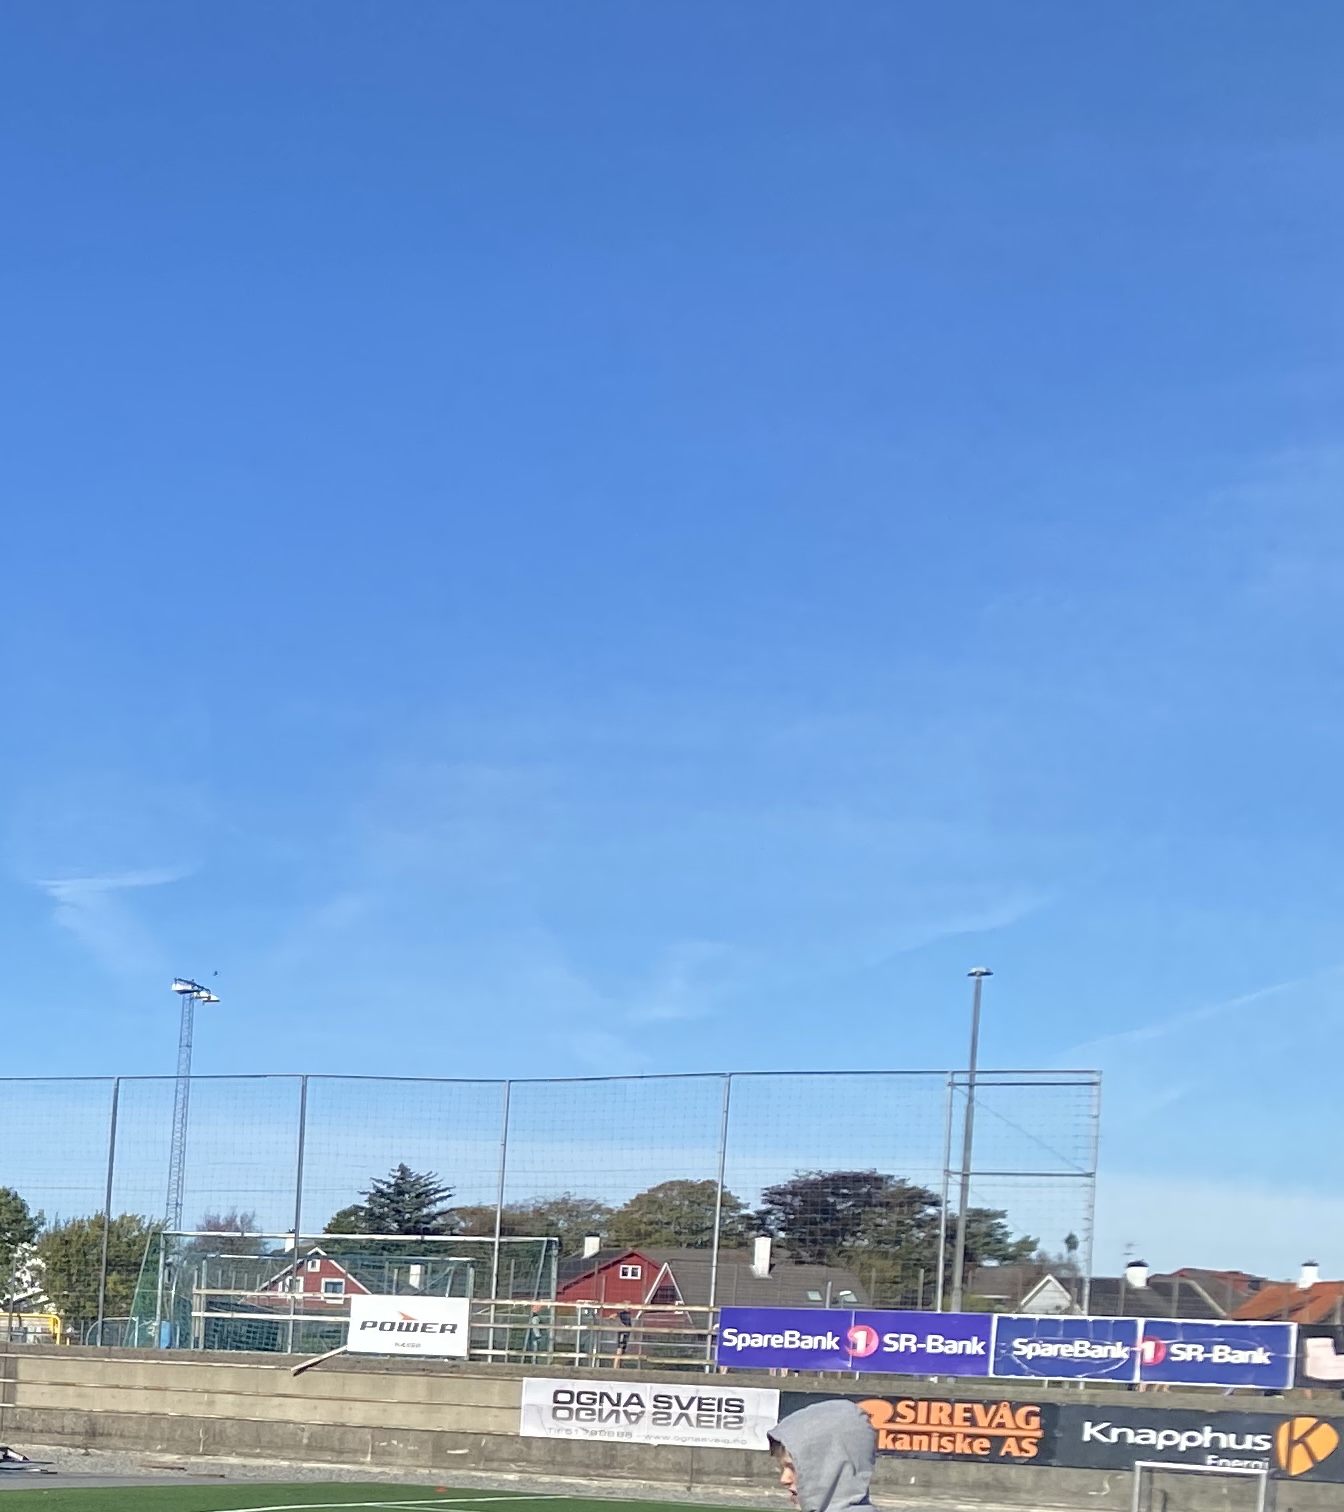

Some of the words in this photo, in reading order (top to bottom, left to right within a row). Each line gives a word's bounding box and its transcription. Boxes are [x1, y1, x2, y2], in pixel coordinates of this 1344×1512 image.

[360, 1320, 458, 1334] POWER
[722, 1328, 840, 1351] SpareBank
[883, 1333, 986, 1356] SR-Bank
[1013, 1338, 1130, 1359] SpareBank
[1169, 1343, 1272, 1365] SR-Bank
[553, 1389, 645, 1409] OGNA
[652, 1393, 745, 1414] SVEIS
[896, 1400, 1041, 1430] SIREVÅG
[1000, 1438, 1039, 1458] AS
[1082, 1421, 1272, 1451] Knapphus
